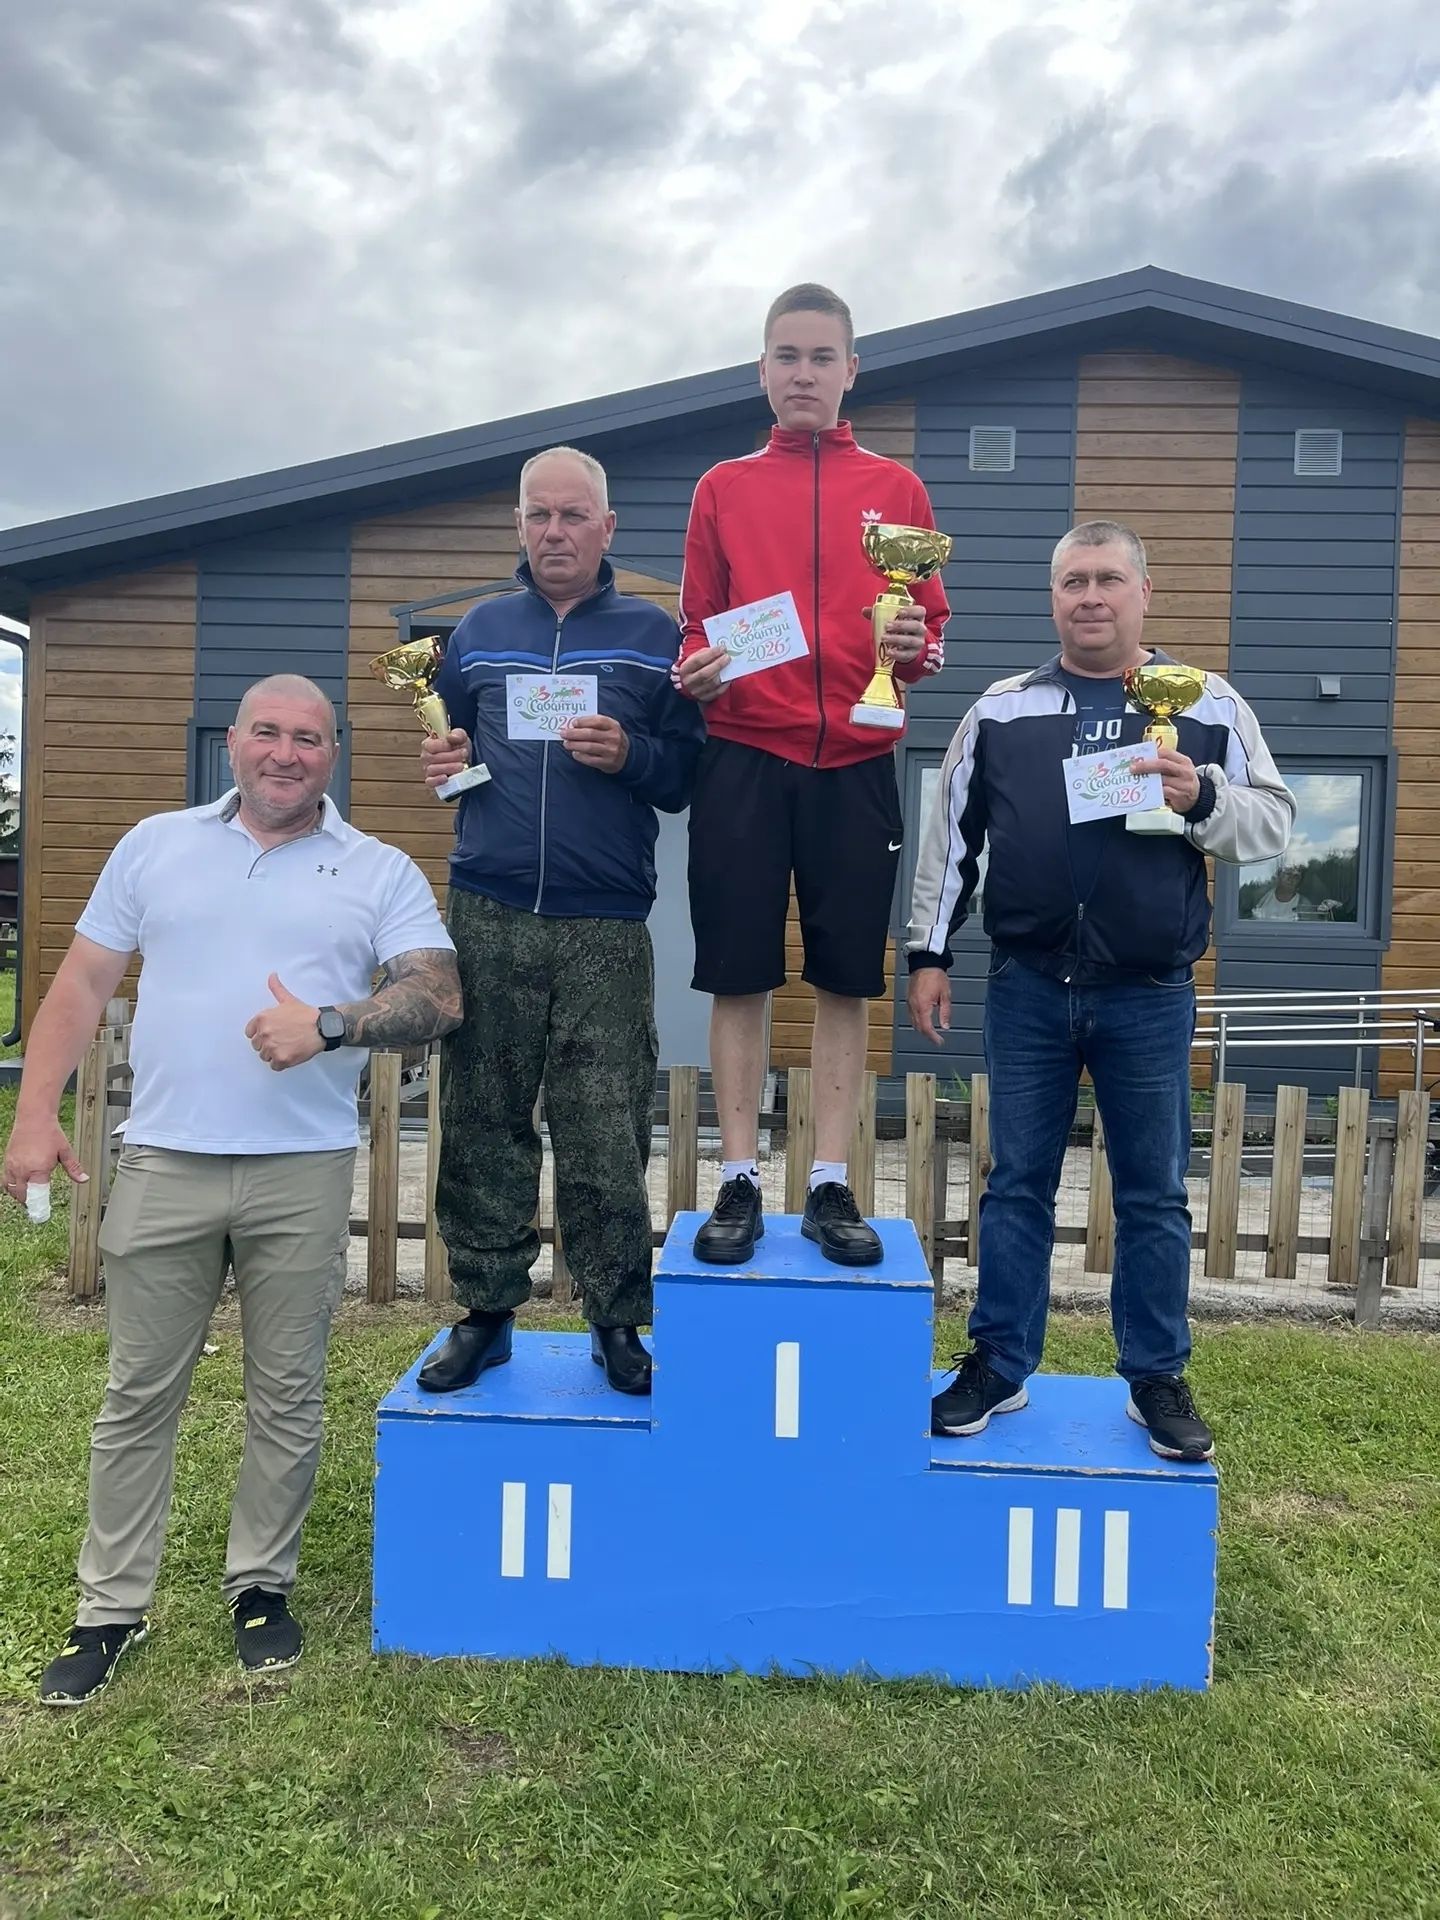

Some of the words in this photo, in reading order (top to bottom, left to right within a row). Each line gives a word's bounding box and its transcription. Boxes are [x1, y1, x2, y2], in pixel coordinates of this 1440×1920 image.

[733, 619, 790, 648] Сабантуй
[747, 640, 786, 662] 2026
[529, 699, 587, 715] Сабантуй
[1101, 786, 1140, 808] 2026
